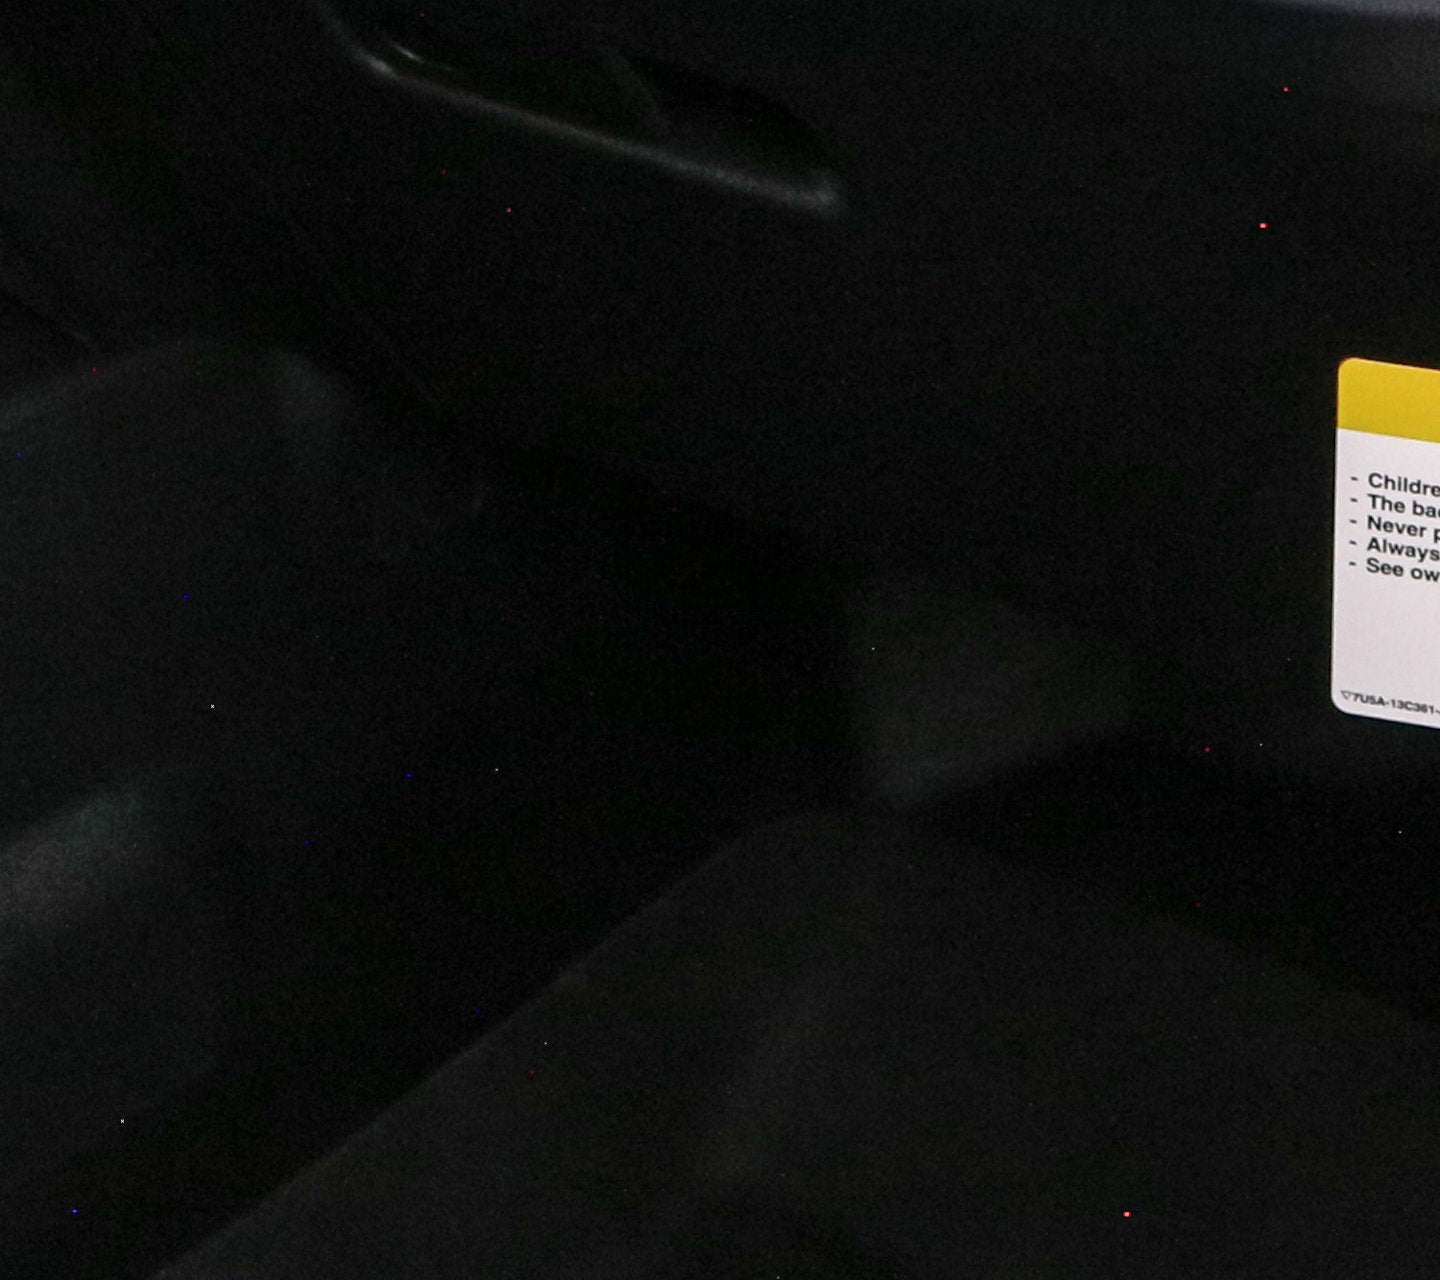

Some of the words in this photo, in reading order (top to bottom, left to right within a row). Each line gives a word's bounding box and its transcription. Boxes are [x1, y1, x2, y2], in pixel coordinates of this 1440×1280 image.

[1366, 492, 1406, 514] The
[1366, 514, 1428, 539] Never
[1366, 535, 1440, 564] Always
[1365, 556, 1405, 578] See
